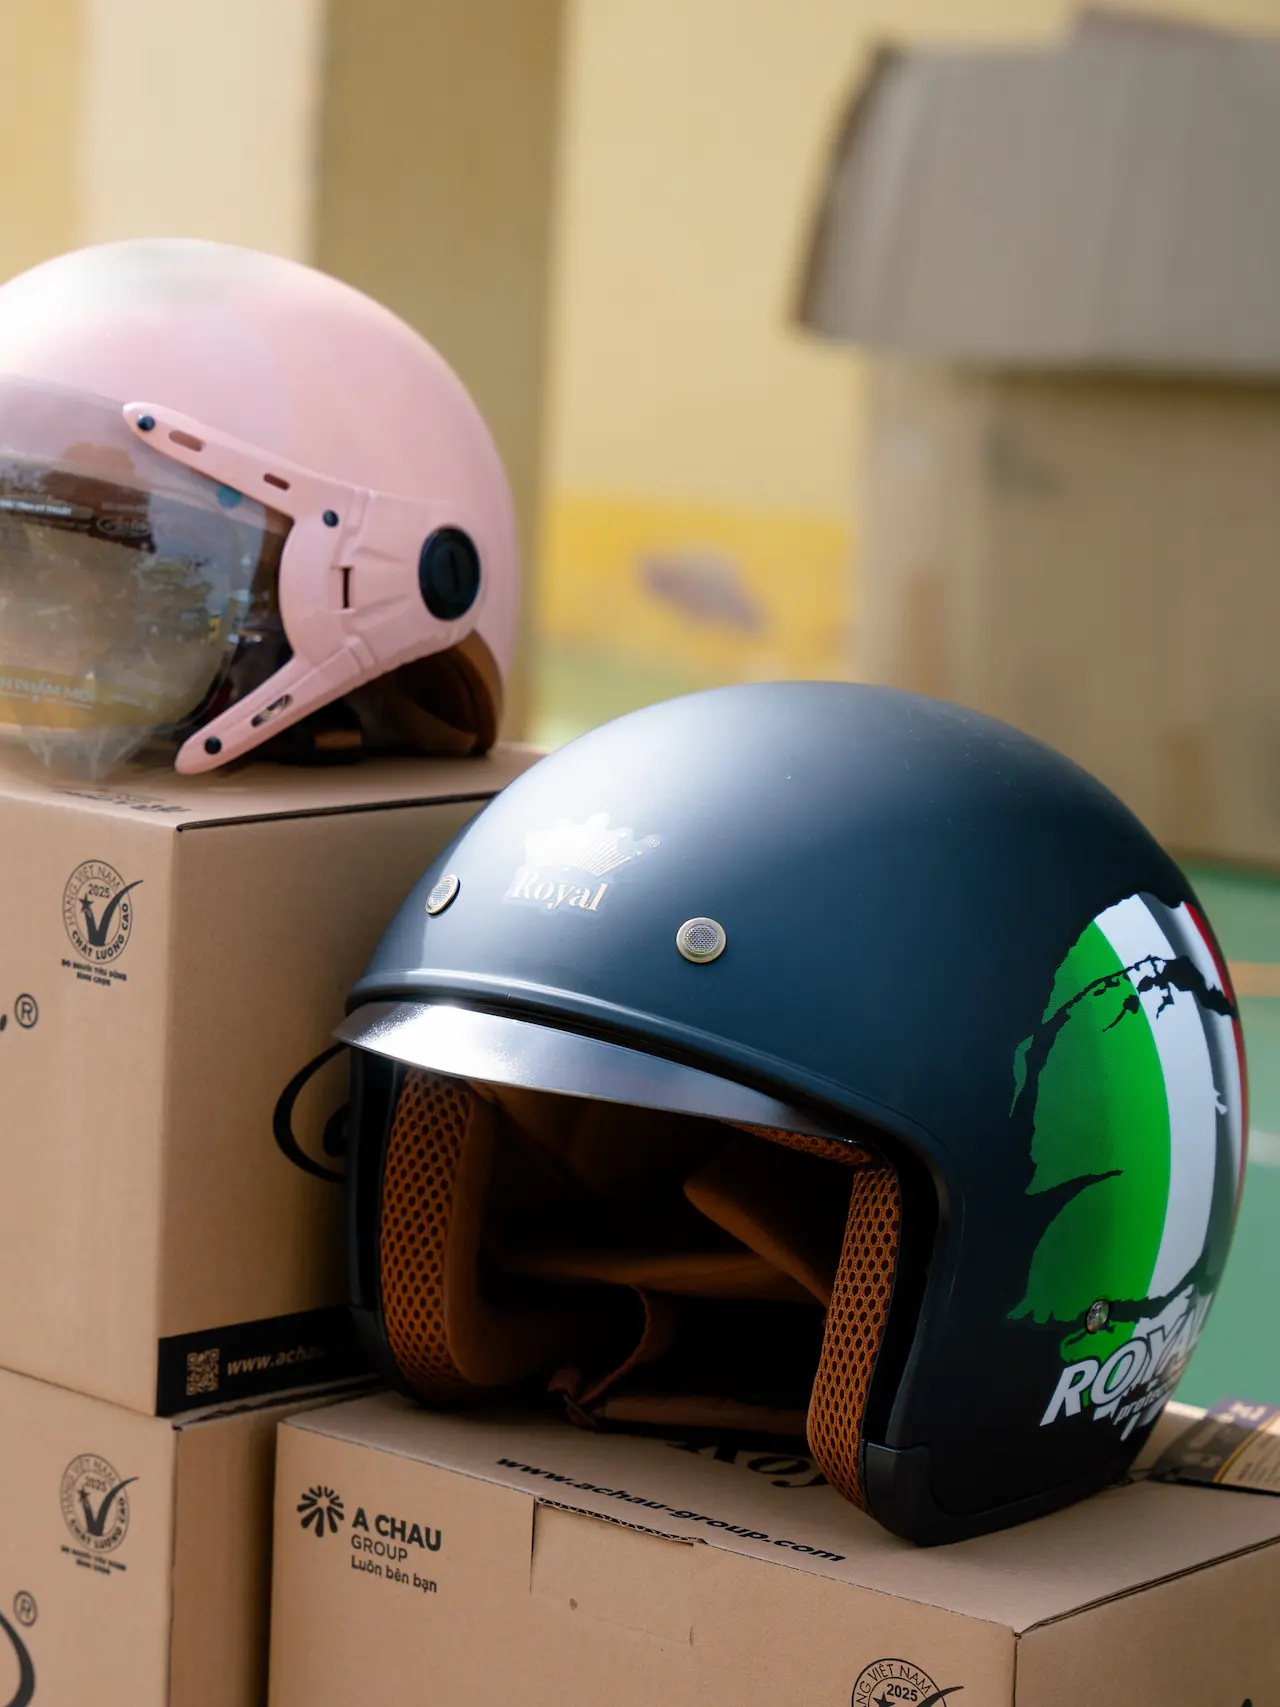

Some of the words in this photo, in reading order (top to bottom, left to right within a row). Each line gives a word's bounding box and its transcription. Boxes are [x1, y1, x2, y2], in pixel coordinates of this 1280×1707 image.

[88, 884, 110, 899] 2025
[508, 870, 608, 912] Royal
[495, 1457, 846, 1562] www.achau-group.com
[352, 1507, 369, 1532] A
[375, 1514, 442, 1551] CHAU
[351, 1534, 408, 1562] GROUP
[351, 1555, 382, 1577] Luôn
[386, 1565, 409, 1585] bên
[413, 1573, 437, 1593] bạn
[886, 1683, 918, 1702] 2025
[900, 1665, 932, 1694] NAM
